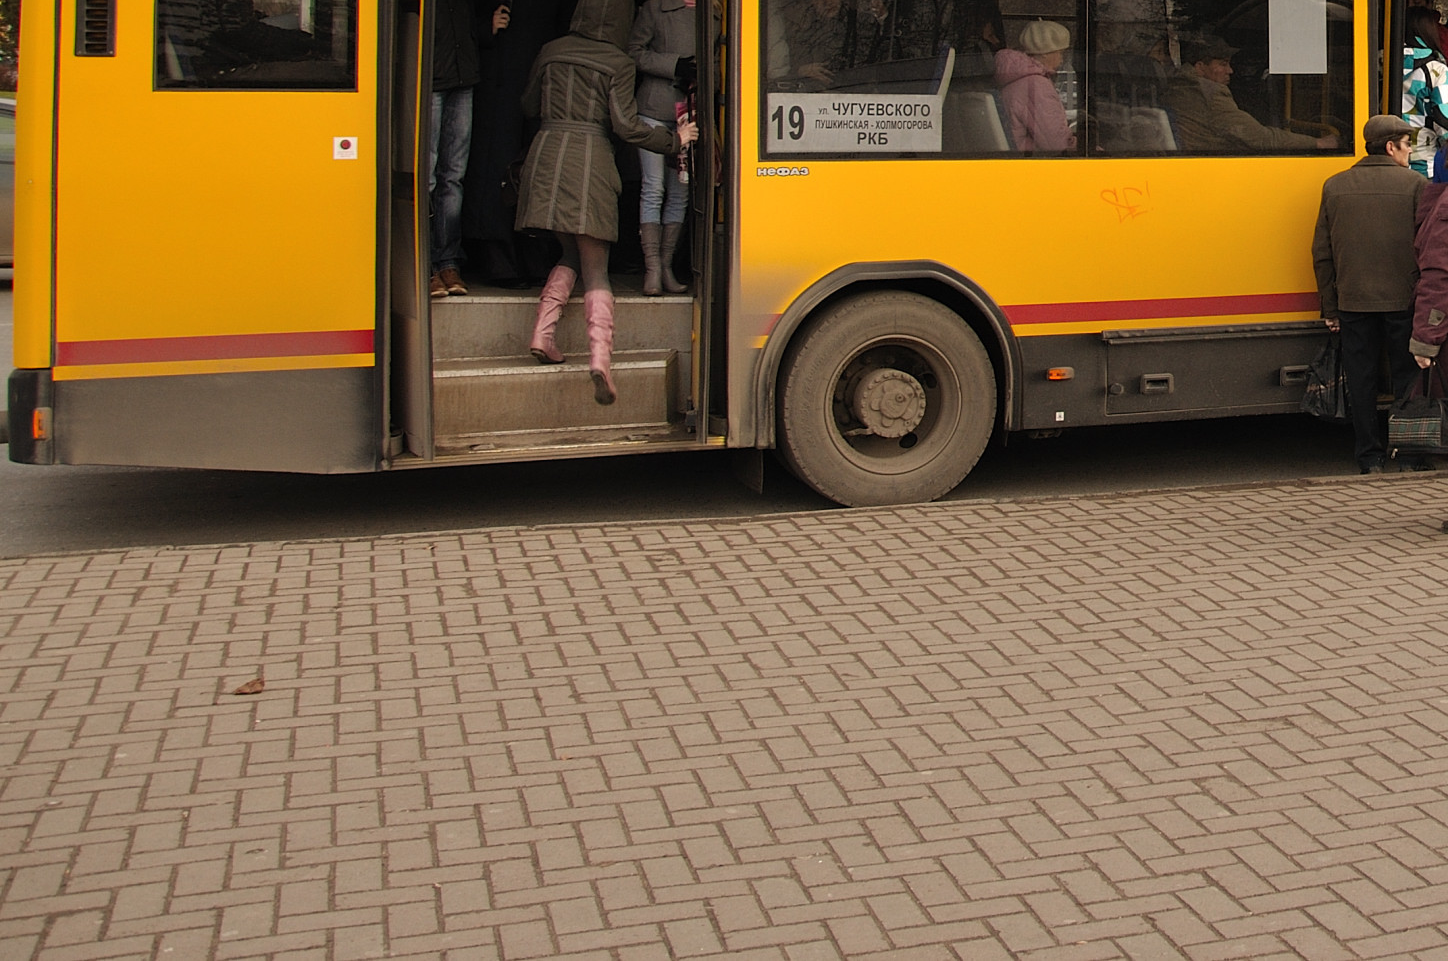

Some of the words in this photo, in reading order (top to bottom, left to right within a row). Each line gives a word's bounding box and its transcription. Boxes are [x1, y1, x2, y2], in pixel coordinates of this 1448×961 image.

[832, 102, 931, 117] ЧУГУЕВСКОГО
[771, 105, 805, 141] 19
[815, 120, 869, 130] ПУШКИНСКАЯ
[875, 120, 933, 130] ХОЛМОГОРОВА
[857, 132, 889, 146] РКБ
